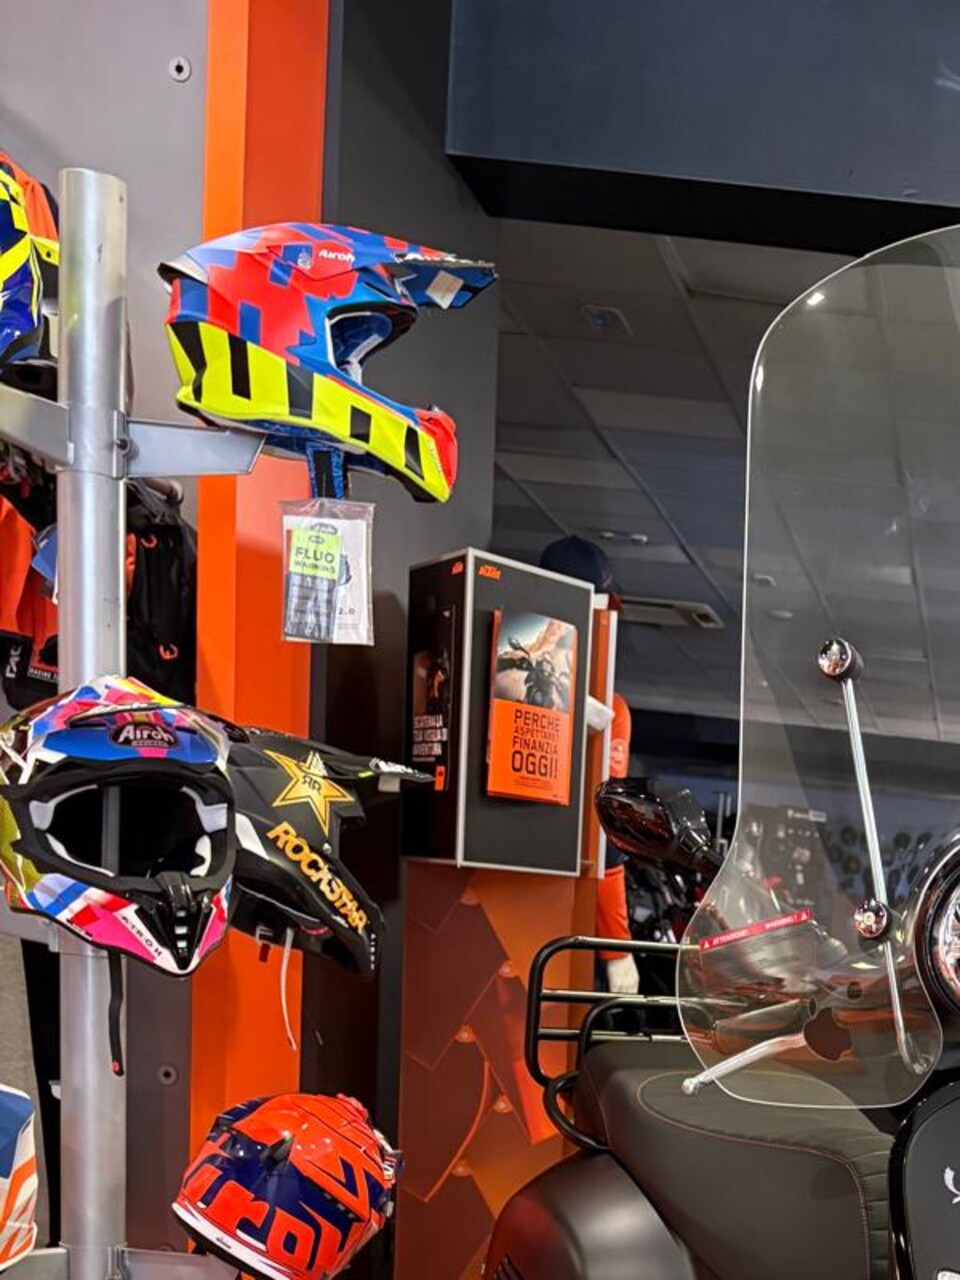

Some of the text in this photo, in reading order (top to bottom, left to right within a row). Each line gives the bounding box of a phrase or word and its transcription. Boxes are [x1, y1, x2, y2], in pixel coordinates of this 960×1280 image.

[295, 547, 336, 564] FLUO
[118, 724, 175, 744] Airoh
[266, 821, 370, 935] ROCKSTAR
